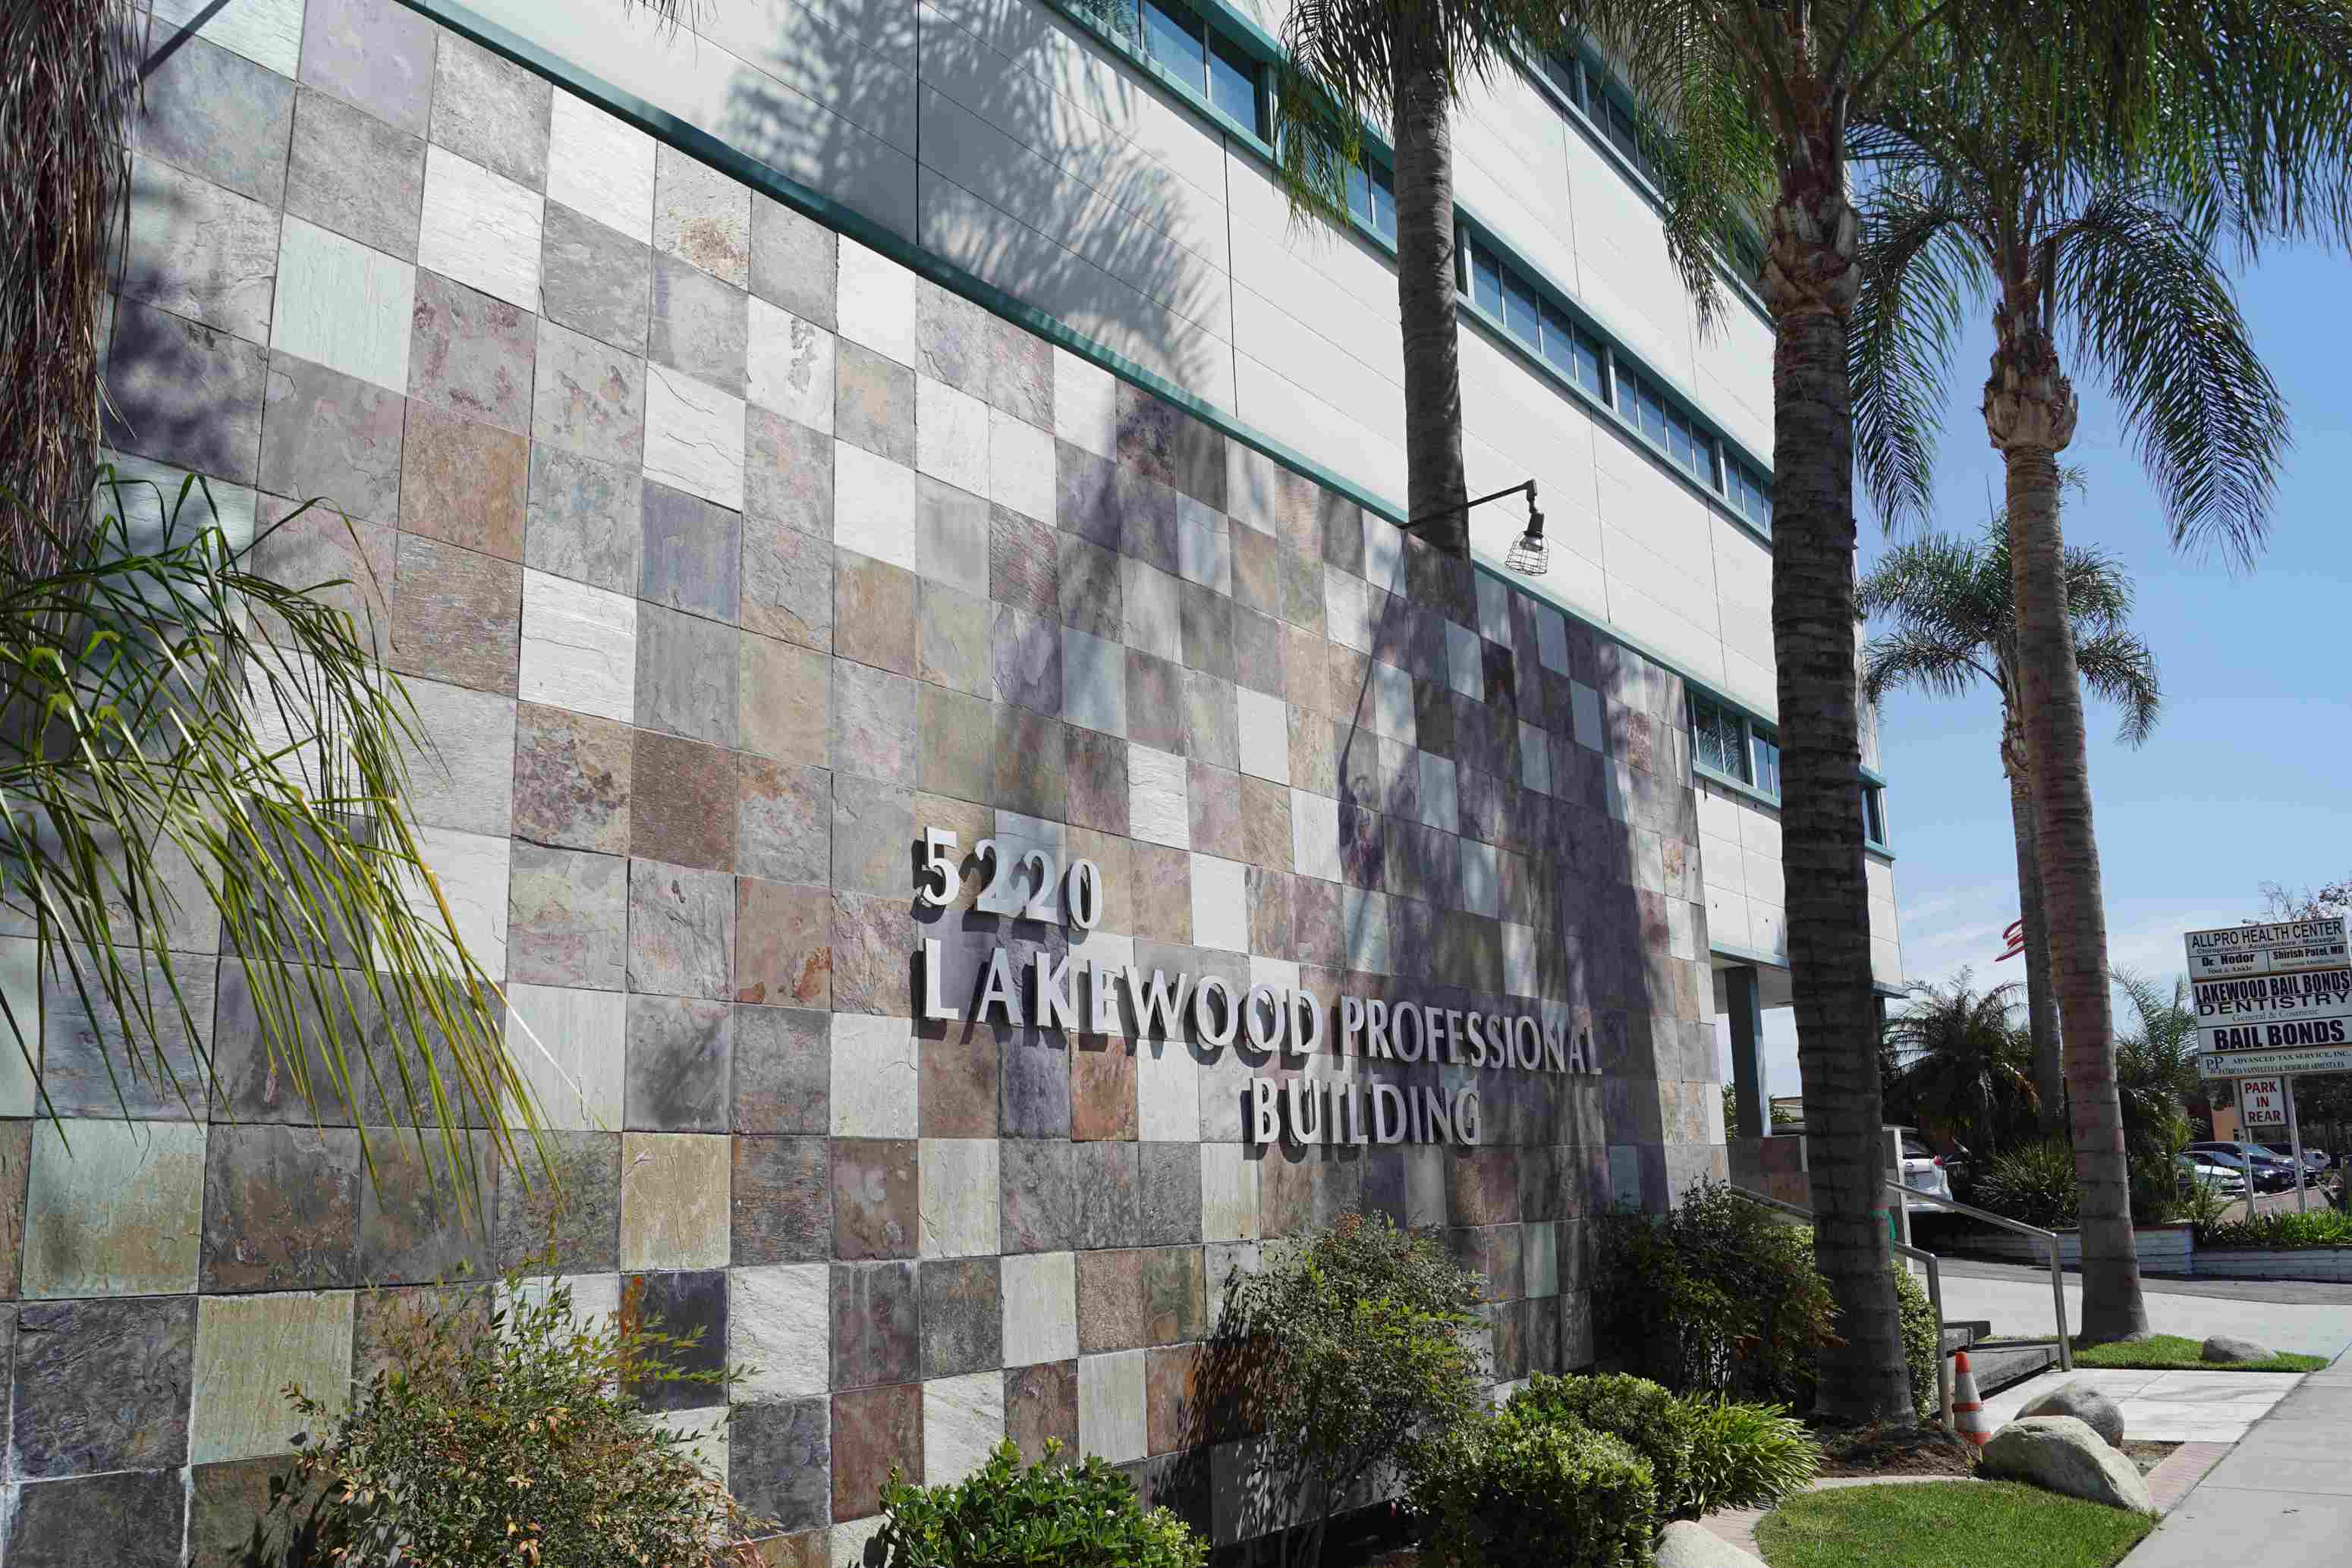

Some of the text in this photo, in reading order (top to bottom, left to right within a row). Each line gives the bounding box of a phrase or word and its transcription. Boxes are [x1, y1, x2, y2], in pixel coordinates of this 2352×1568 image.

[922, 826, 1103, 929] 5220
[2192, 921, 2342, 948] ALLPRO HEALTH CENTER
[2273, 948, 2303, 960] Shirish
[2195, 970, 2350, 1003] LAKEWOOD BAIL BONDS
[923, 938, 1602, 1074] LAKEWOOD PROFESSIONAL
[2199, 991, 2350, 1016] DENTISTRY
[2233, 1010, 2265, 1022] General
[2269, 1010, 2276, 1018] &
[2213, 1020, 2344, 1051] BAIL BONDS
[2245, 1080, 2277, 1093] PARK
[1252, 1077, 1482, 1145] BUILDING
[2256, 1096, 2269, 1108] IN
[2247, 1110, 2281, 1123] REAR
